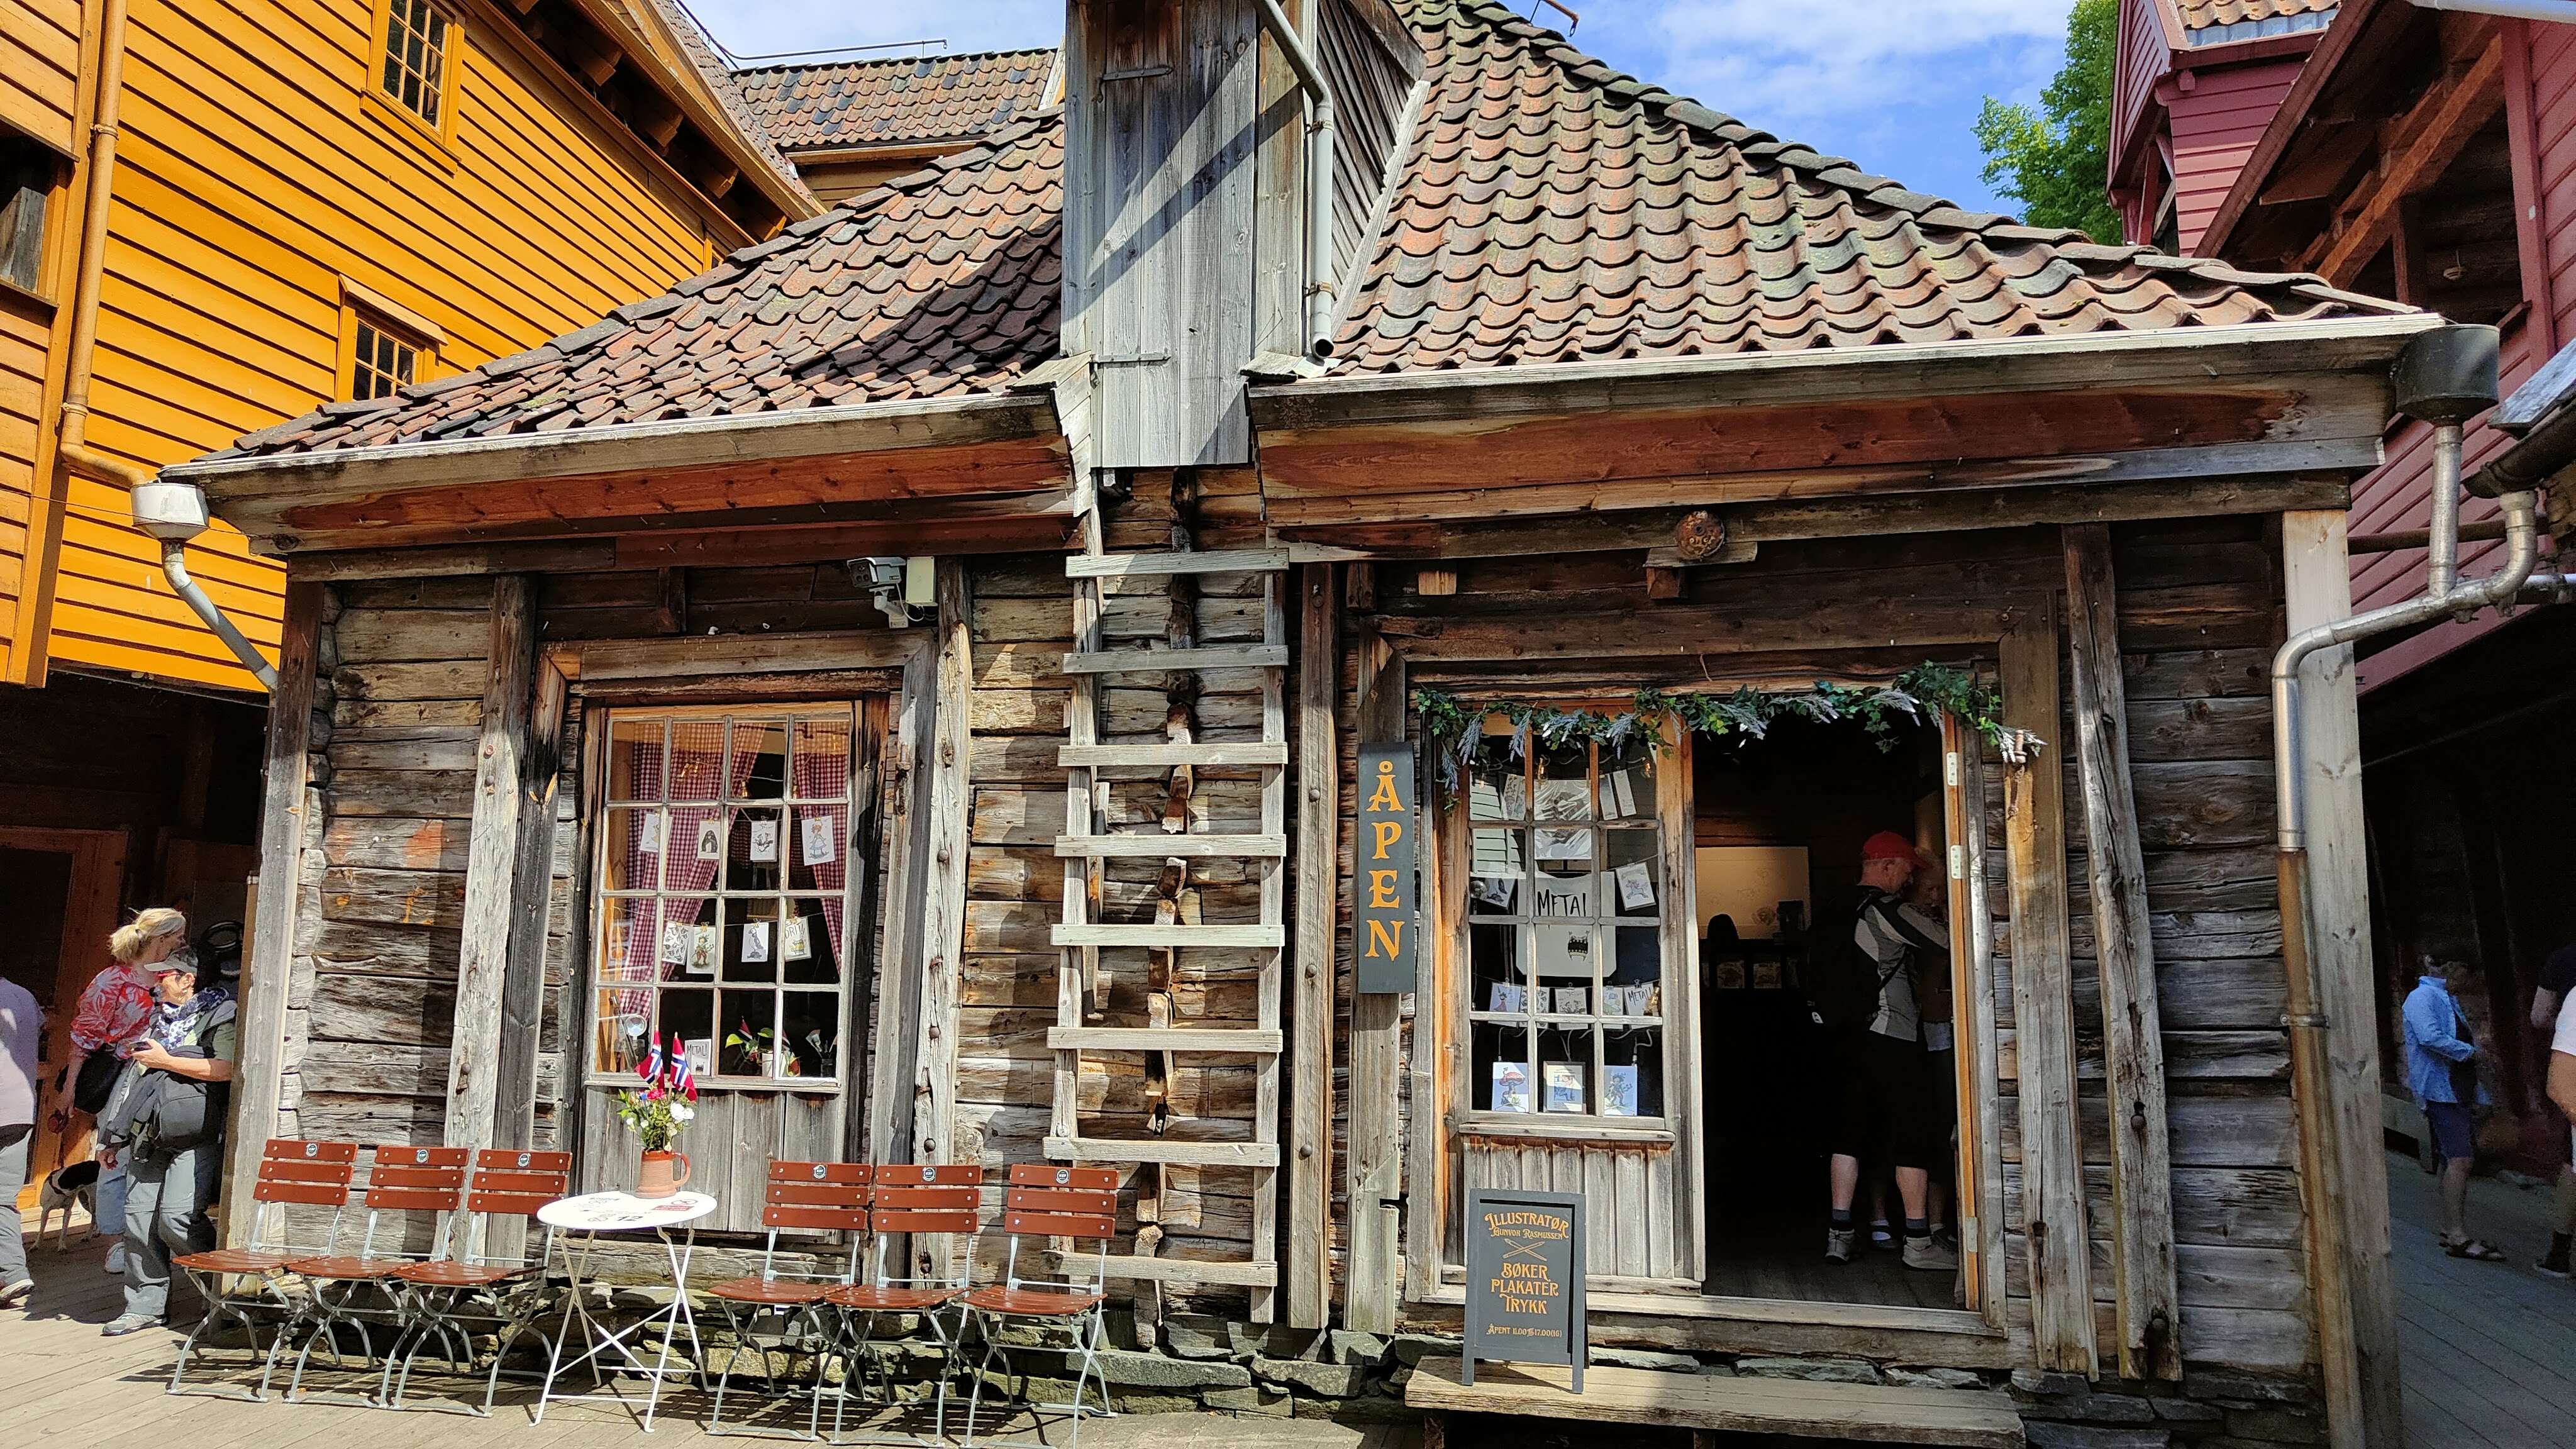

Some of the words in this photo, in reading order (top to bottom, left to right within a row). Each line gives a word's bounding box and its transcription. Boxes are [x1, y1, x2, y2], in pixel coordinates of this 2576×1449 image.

[1364, 760, 1406, 962] ÅPEN
[1484, 1211, 1570, 1239] ILLUSTRATØR
[1491, 1227, 1521, 1237] GUNVOR
[1522, 1228, 1563, 1240] RASMUSSEN
[1501, 1262, 1552, 1282] BØKER
[1491, 1279, 1559, 1297] PLAKATER
[1499, 1293, 1548, 1314] TRYKK
[1485, 1323, 1511, 1335] ÅPENT
